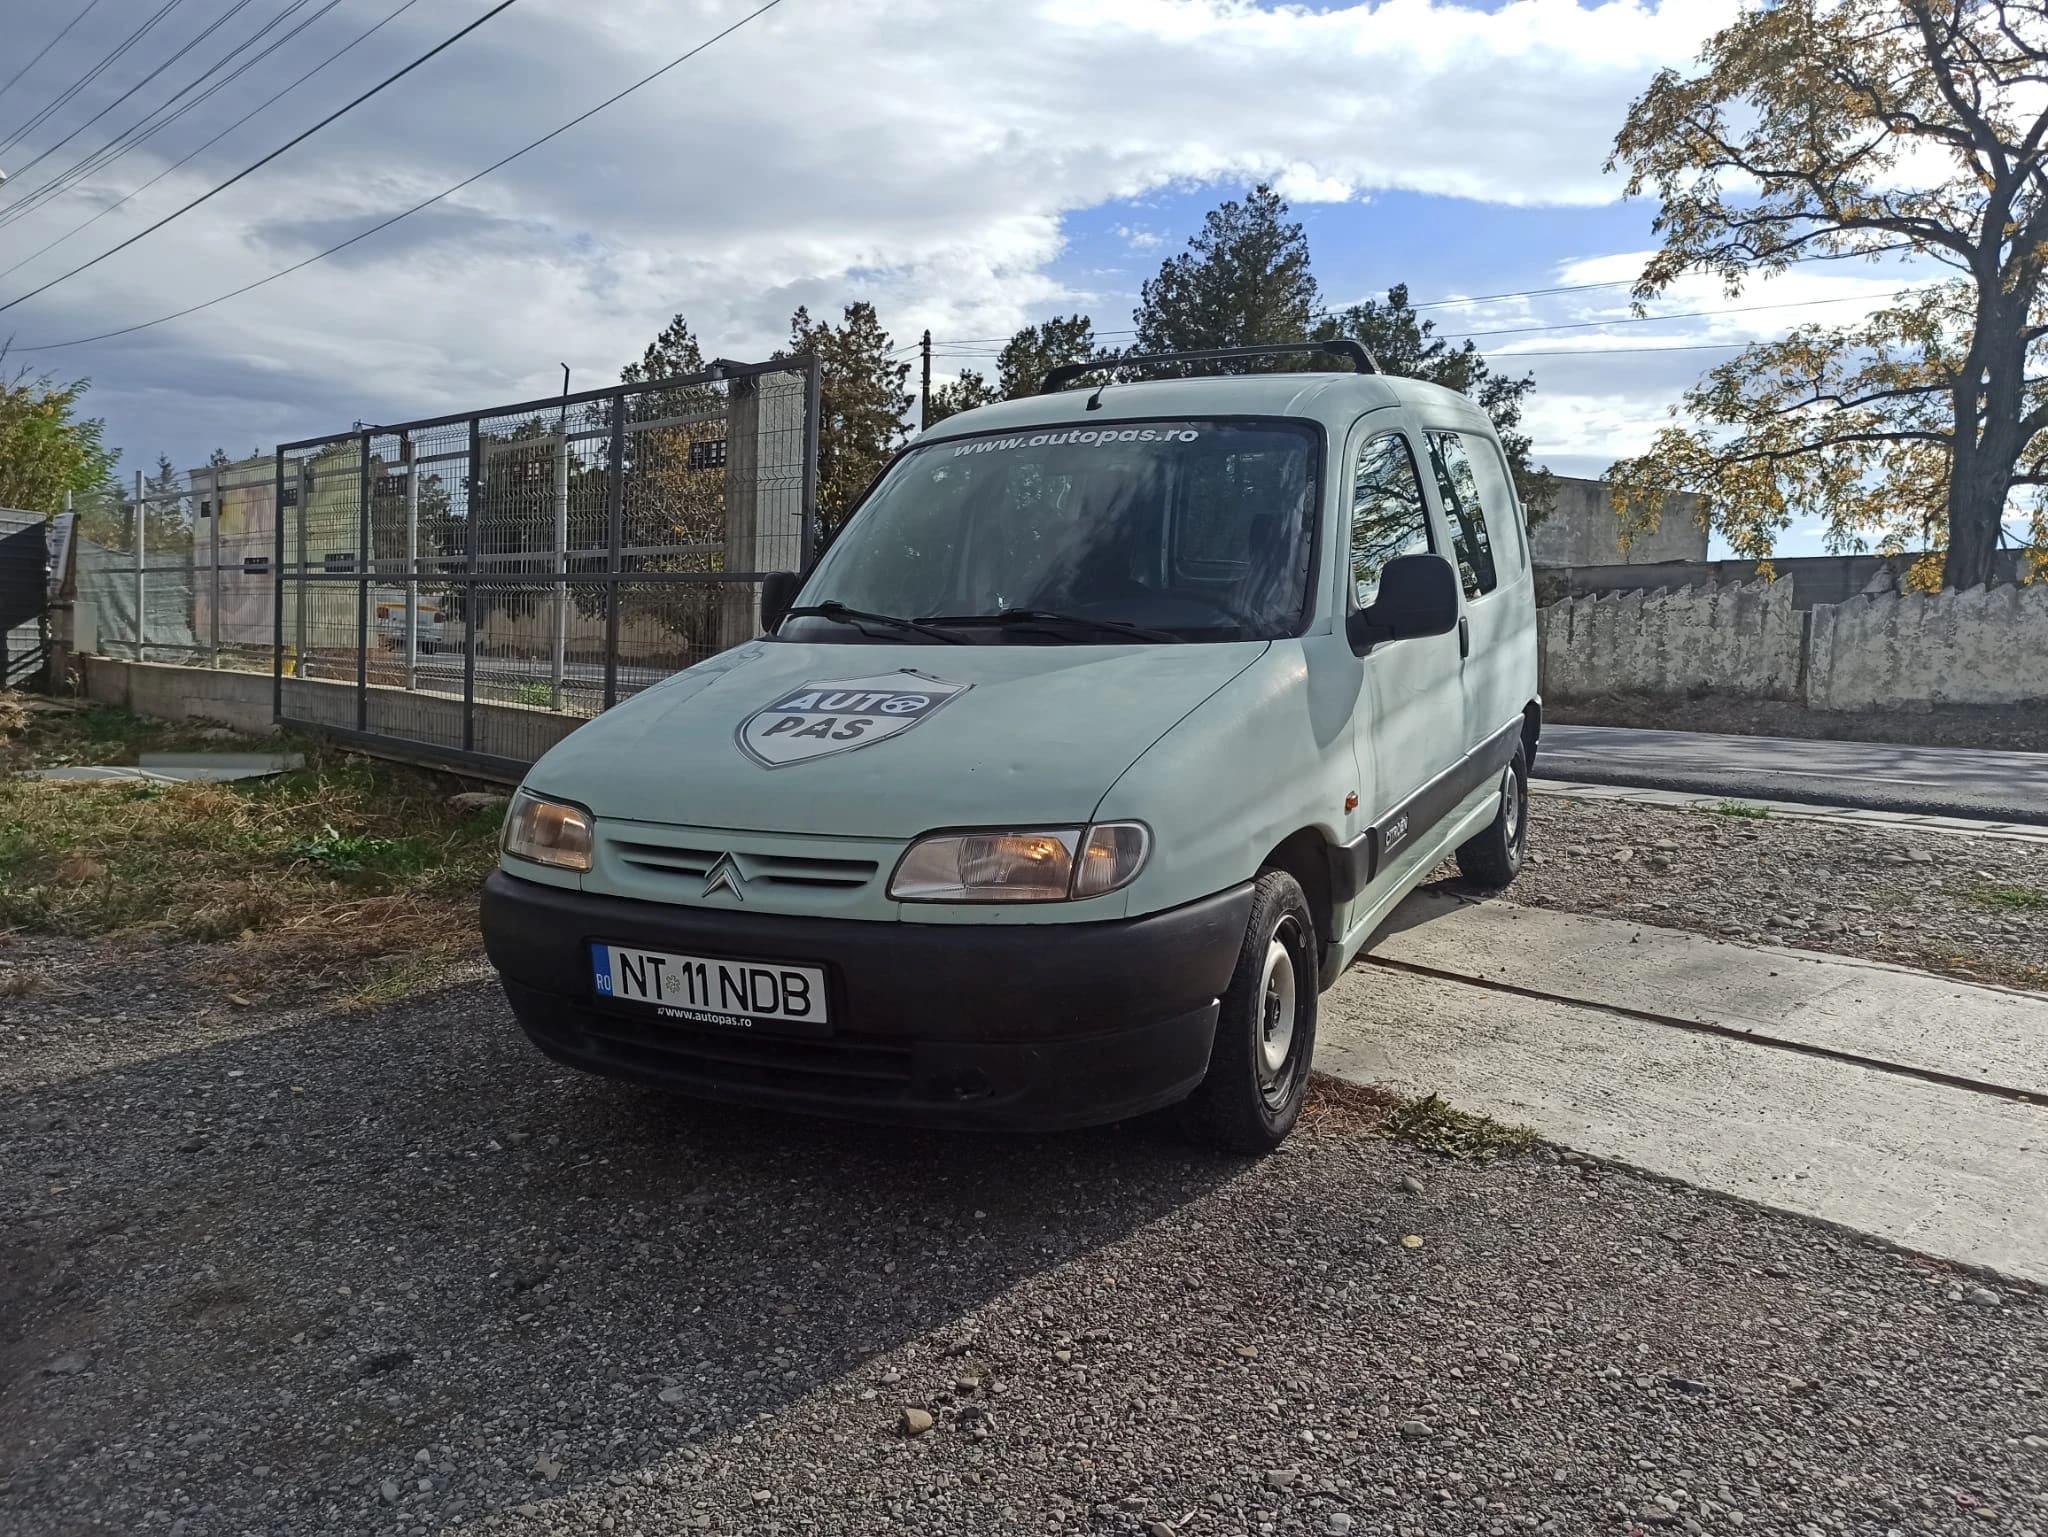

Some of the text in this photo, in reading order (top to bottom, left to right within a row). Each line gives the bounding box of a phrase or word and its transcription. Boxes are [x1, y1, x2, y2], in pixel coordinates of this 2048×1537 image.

[953, 429, 1199, 457] www.autopas.ro
[761, 716, 874, 740] PAS
[596, 973, 611, 991] RO
[619, 953, 811, 1017] NT 11 NDB
[665, 1007, 752, 1028] www.autopas.ro
